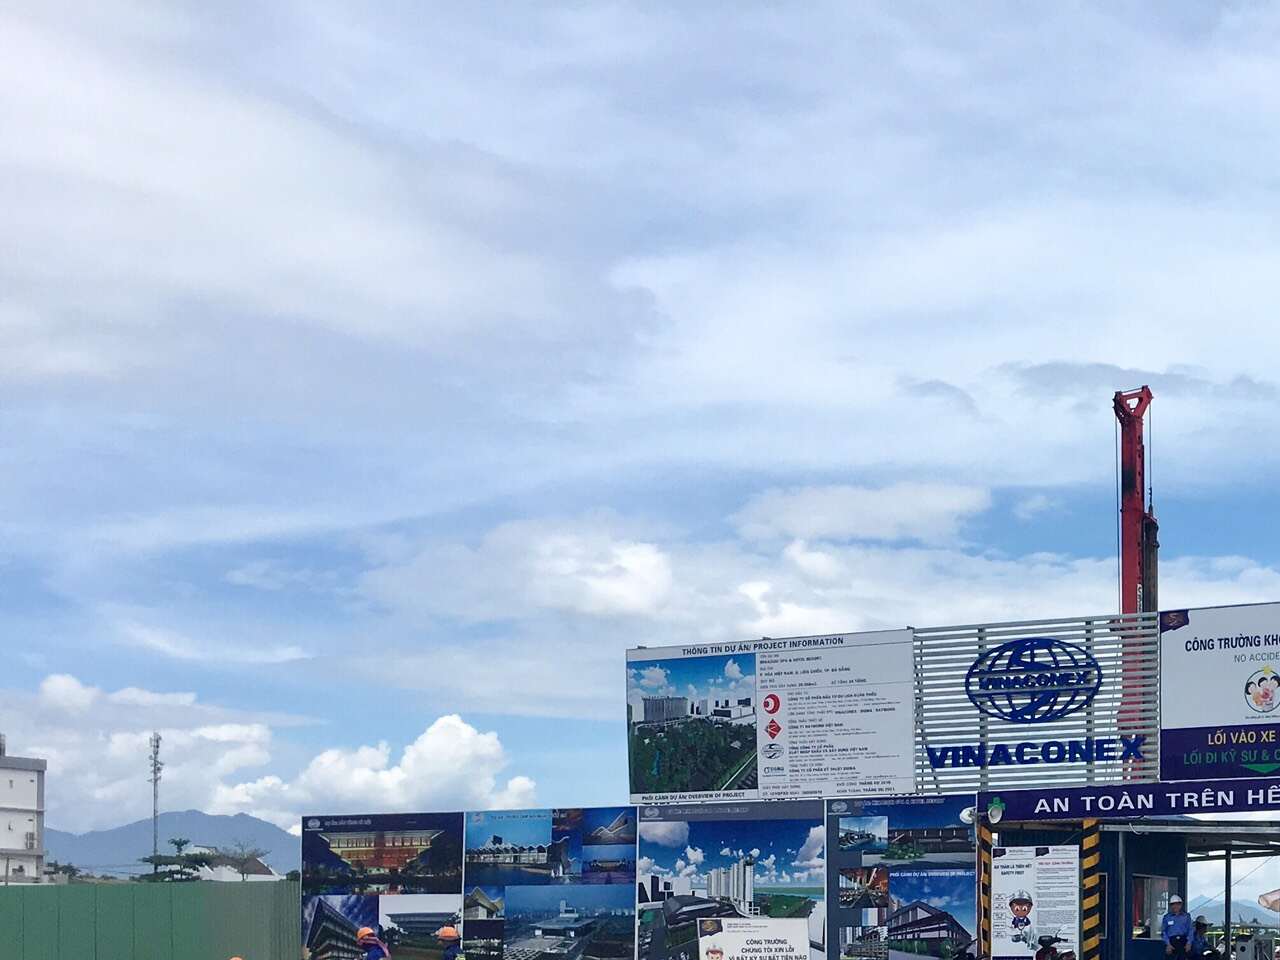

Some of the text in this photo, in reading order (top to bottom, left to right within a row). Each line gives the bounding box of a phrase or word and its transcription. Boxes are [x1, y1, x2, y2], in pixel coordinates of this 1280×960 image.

[682, 646, 708, 656] THÔNG
[710, 645, 722, 654] TIN
[725, 645, 736, 653] DỰ
[754, 641, 787, 650] PROJECT
[789, 637, 844, 649] INFORMATION
[1185, 637, 1215, 652] CÔNG
[1217, 633, 1261, 650] TRƯỜNG
[1234, 653, 1247, 663] NO
[980, 671, 1088, 690] VINACONEX
[1208, 729, 1227, 745] LỐI
[1230, 729, 1256, 744] VÀO
[1260, 730, 1276, 742] XE
[925, 736, 1147, 769] VINACONEX
[1183, 750, 1202, 765] LỐI
[1205, 752, 1217, 763] ĐI
[1241, 750, 1257, 762] SƯ
[1261, 751, 1270, 761] &
[1034, 797, 1069, 814] AN
[1081, 789, 1154, 810] TOÀN
[1166, 788, 1234, 808] TRÊN
